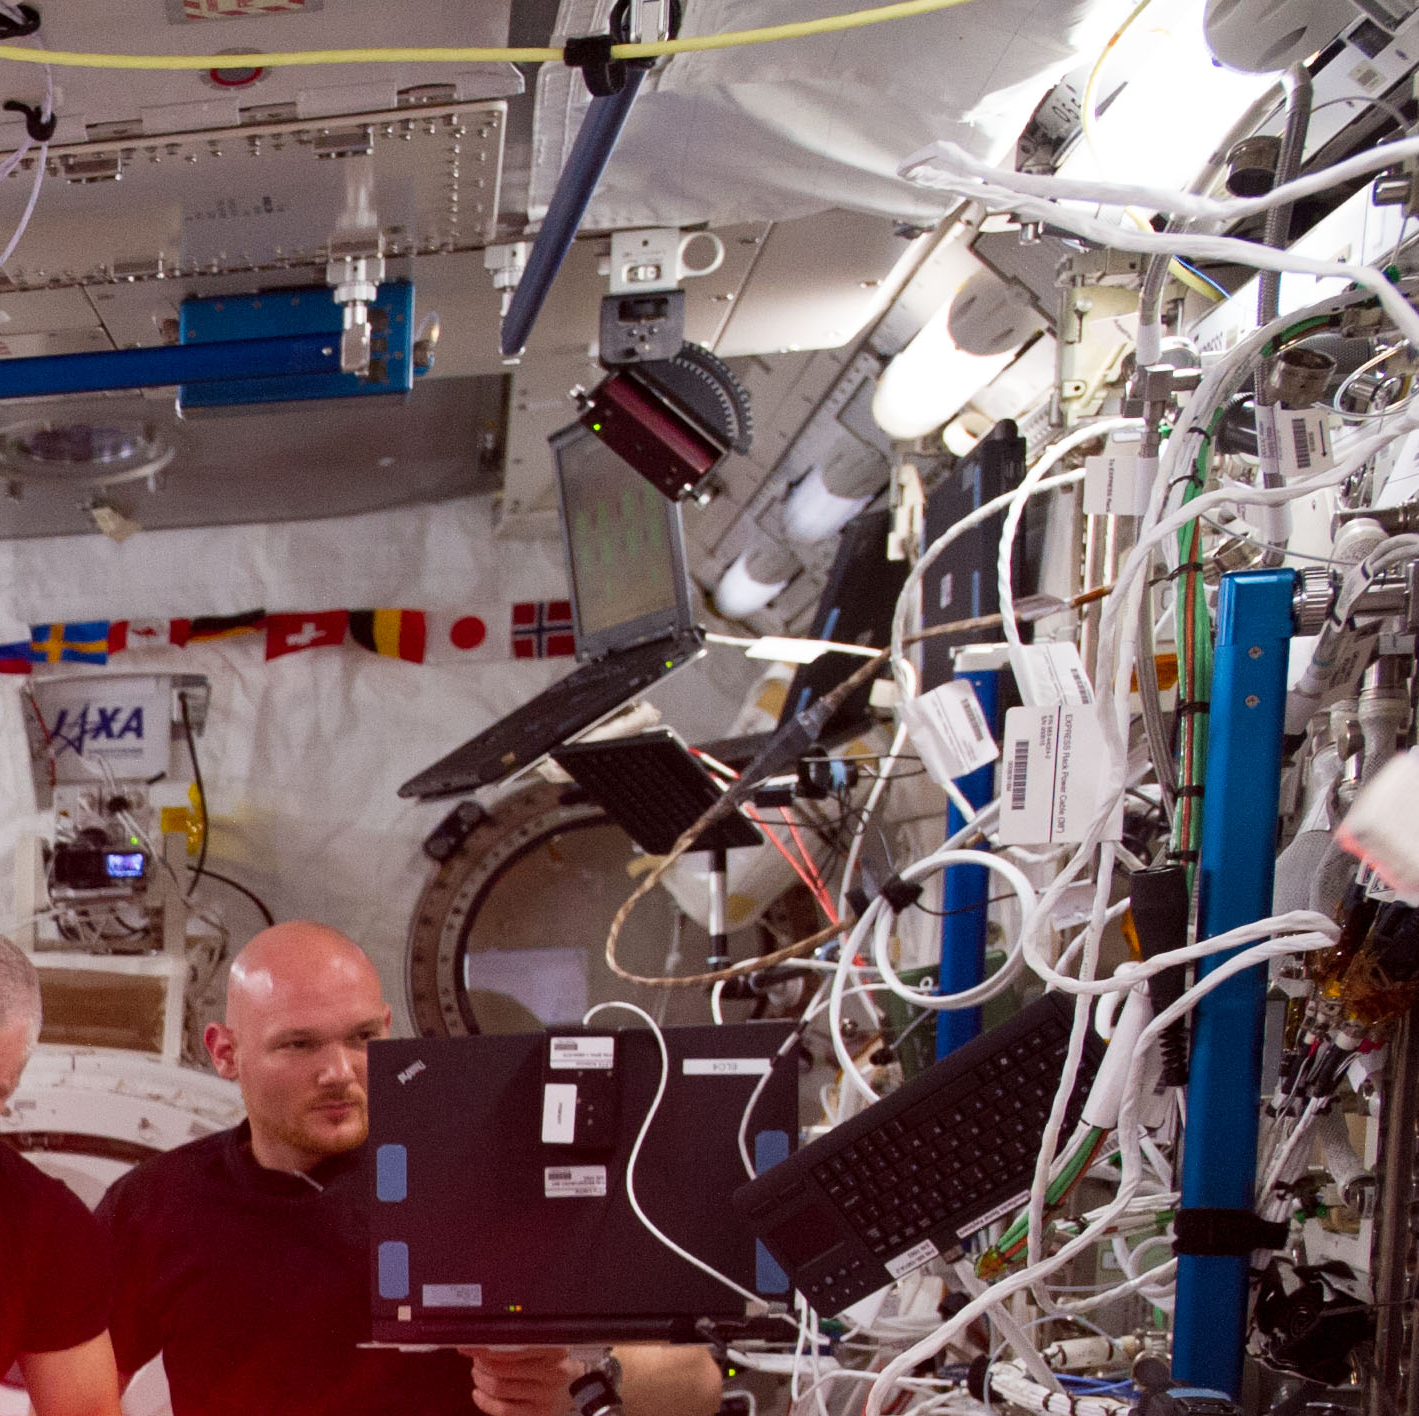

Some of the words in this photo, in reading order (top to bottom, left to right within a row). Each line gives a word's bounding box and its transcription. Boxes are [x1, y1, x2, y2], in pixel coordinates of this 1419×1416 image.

[50, 703, 143, 757] JAXA
[1062, 713, 1073, 752] EXPRESS
[1061, 752, 1070, 771] Rack
[1060, 772, 1069, 793] Power
[1058, 794, 1068, 817] Cable
